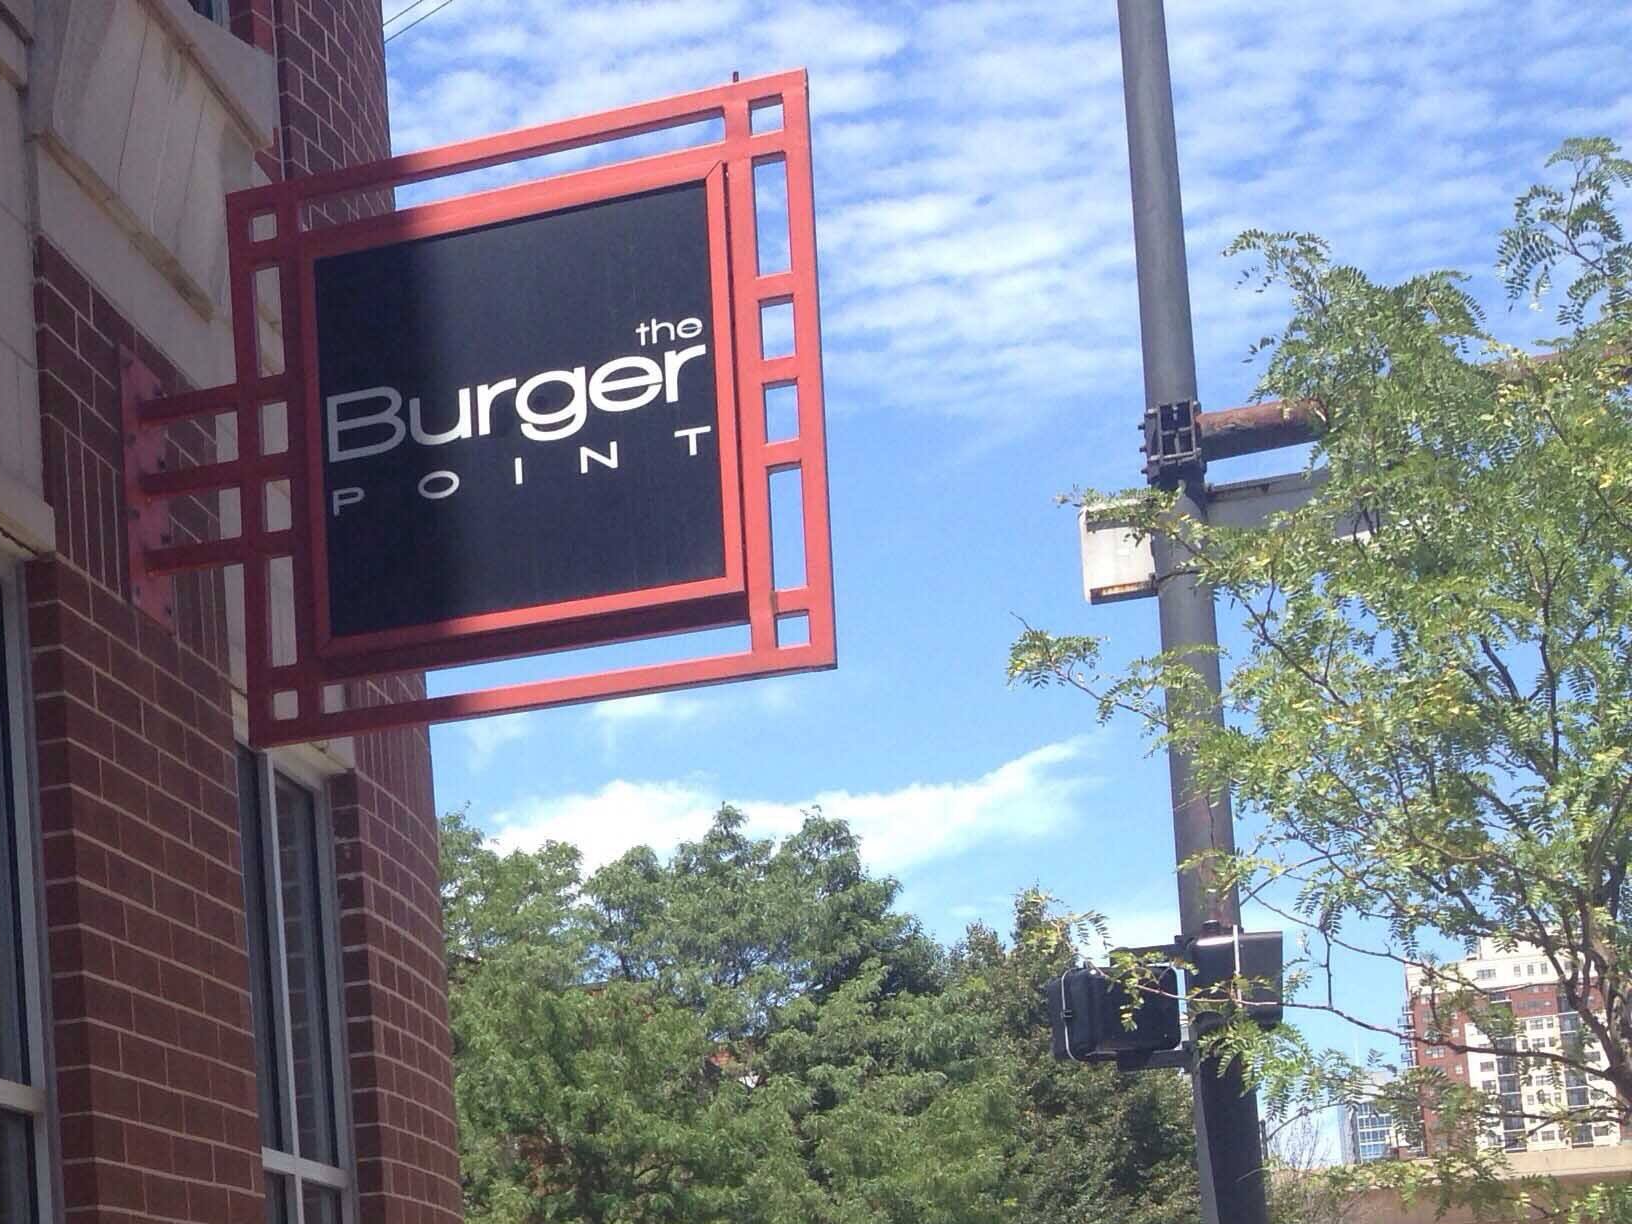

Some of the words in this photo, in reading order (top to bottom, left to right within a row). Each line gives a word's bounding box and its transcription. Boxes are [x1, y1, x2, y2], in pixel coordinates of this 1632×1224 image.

[635, 316, 703, 346] the
[325, 343, 707, 463] Burger
[332, 425, 712, 517] POINT
